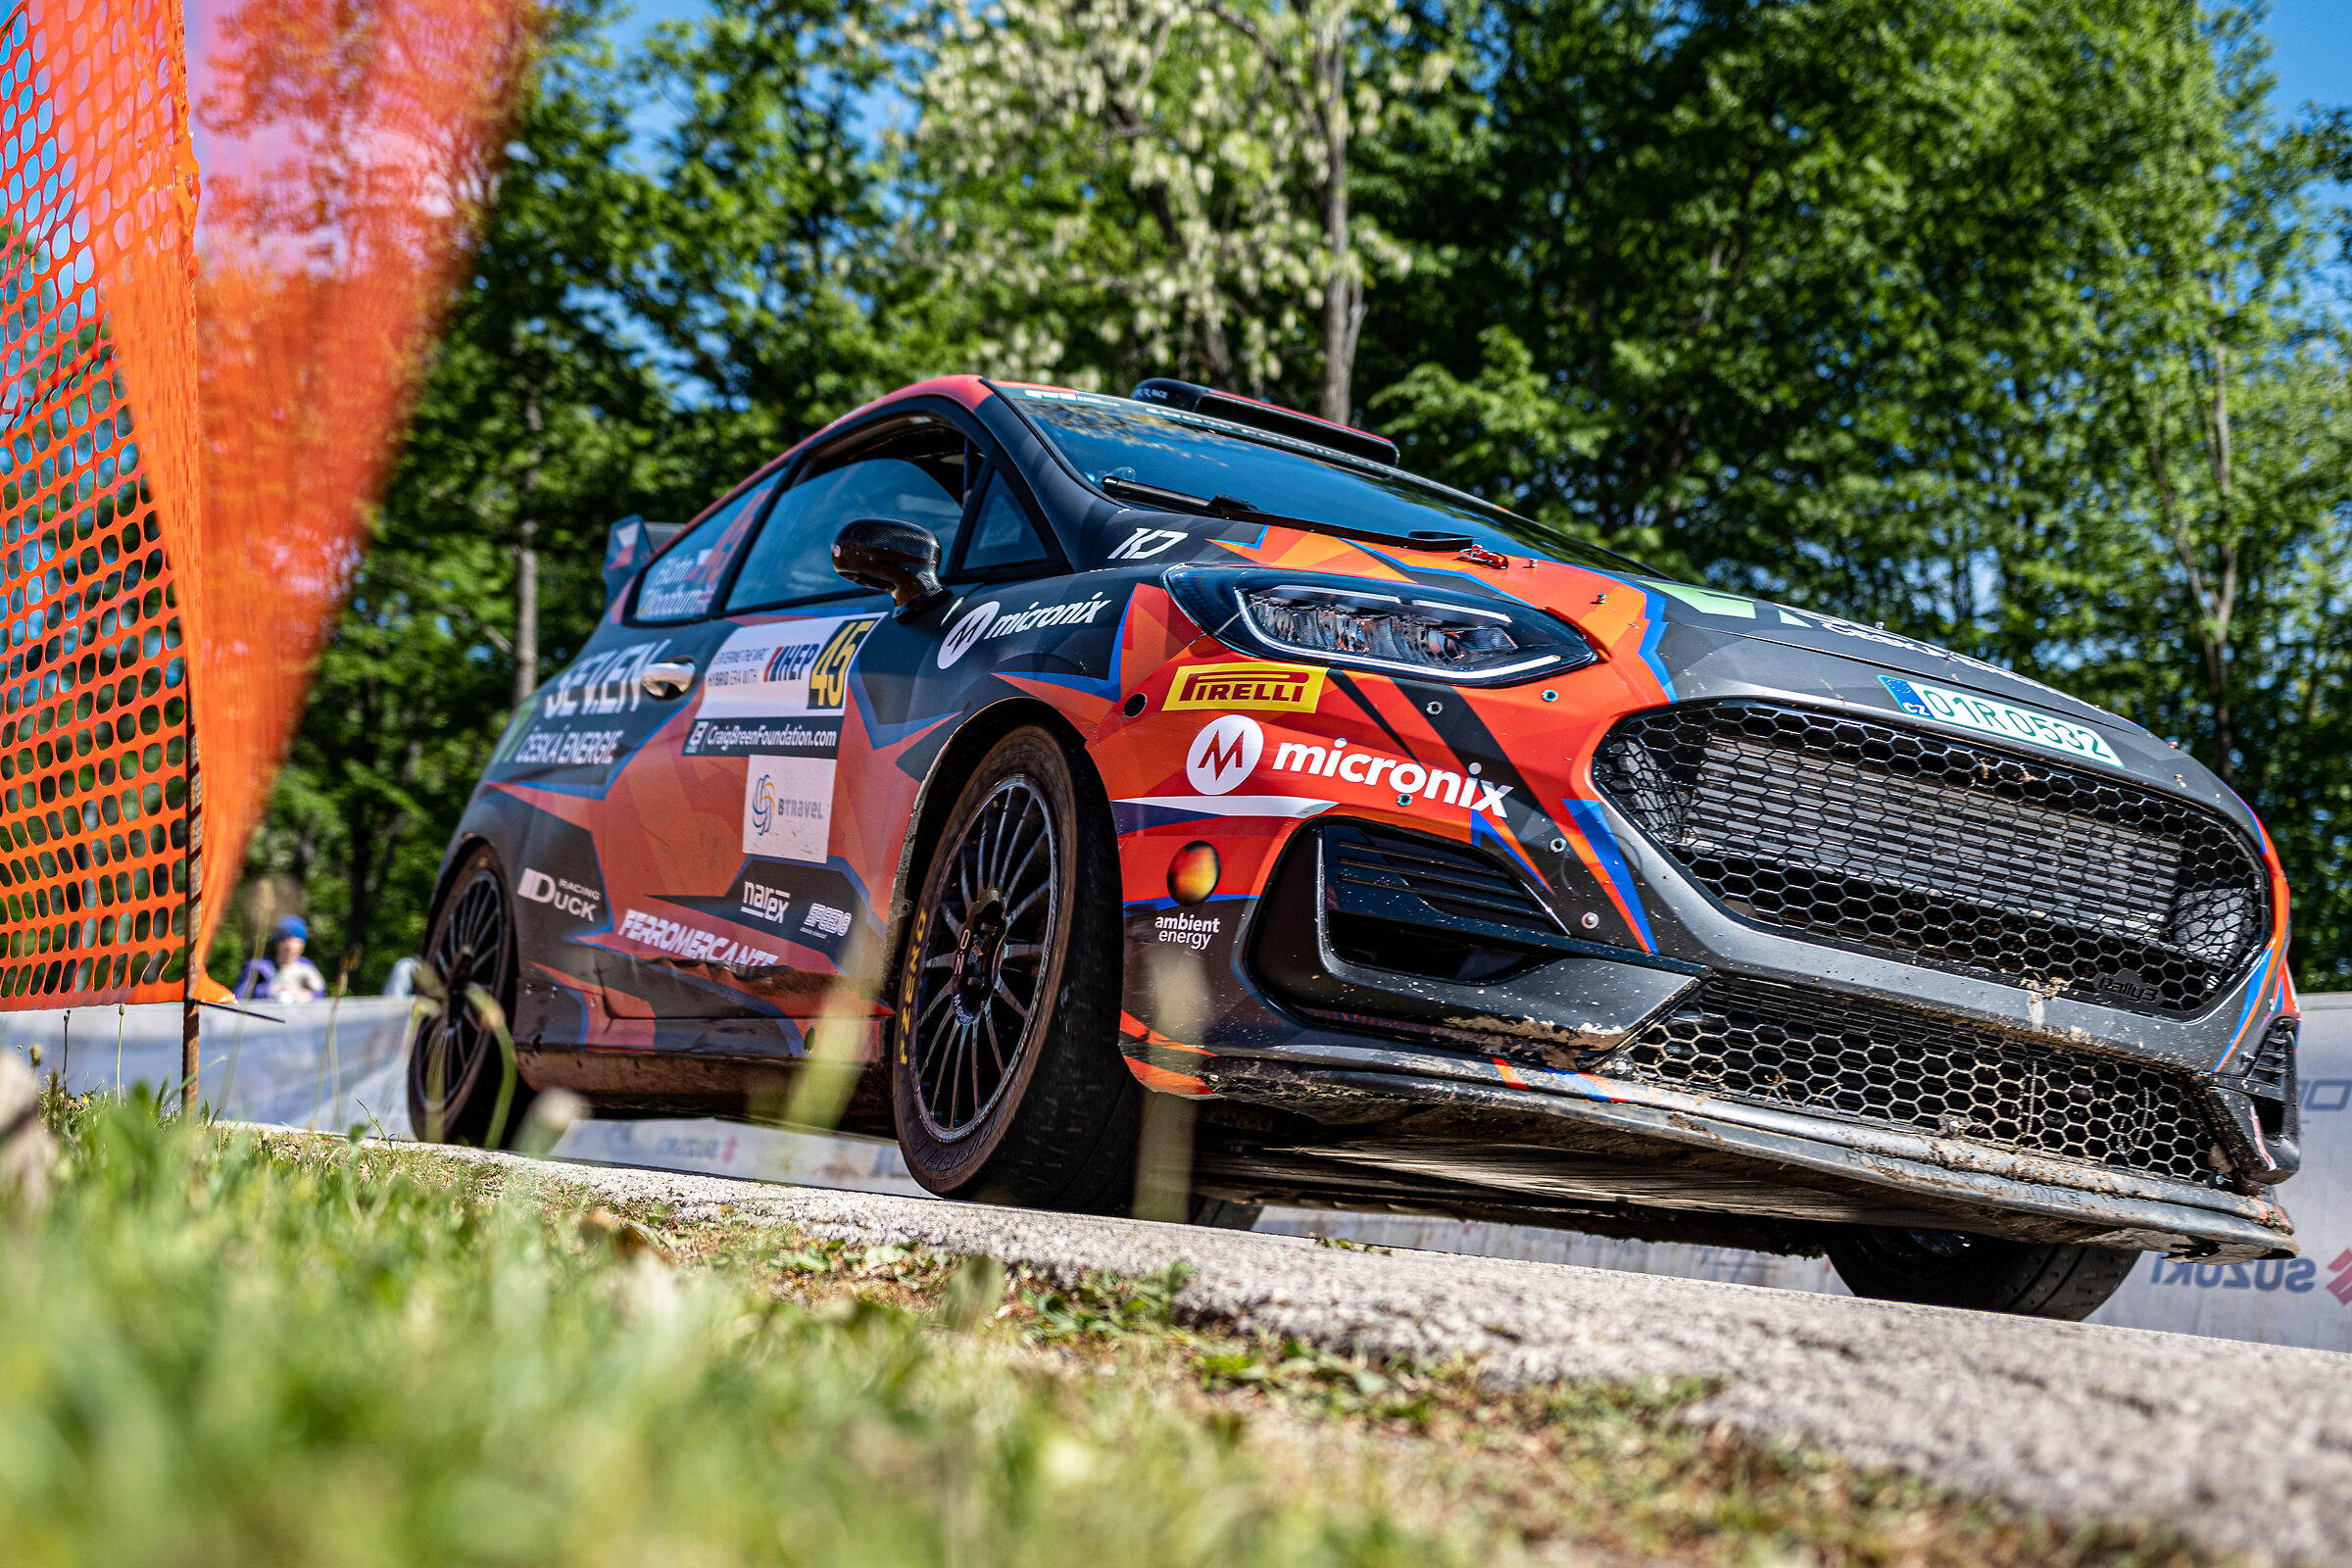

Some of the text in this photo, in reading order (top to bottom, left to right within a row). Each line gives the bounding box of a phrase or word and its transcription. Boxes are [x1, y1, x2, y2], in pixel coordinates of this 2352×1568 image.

[984, 591, 1112, 639] micronix
[810, 619, 876, 707] 45
[1179, 668, 1309, 703] PIRELLI
[1905, 701, 1931, 716] CZ
[707, 723, 837, 752] CraigBreenFoundation.com
[1272, 737, 1514, 818] micronix
[517, 867, 598, 922] DUCK
[558, 878, 603, 902] RACING
[743, 881, 790, 924] narex
[1154, 912, 1221, 933] ambient
[1158, 930, 1212, 951] energy
[2097, 976, 2157, 1003] Rally3
